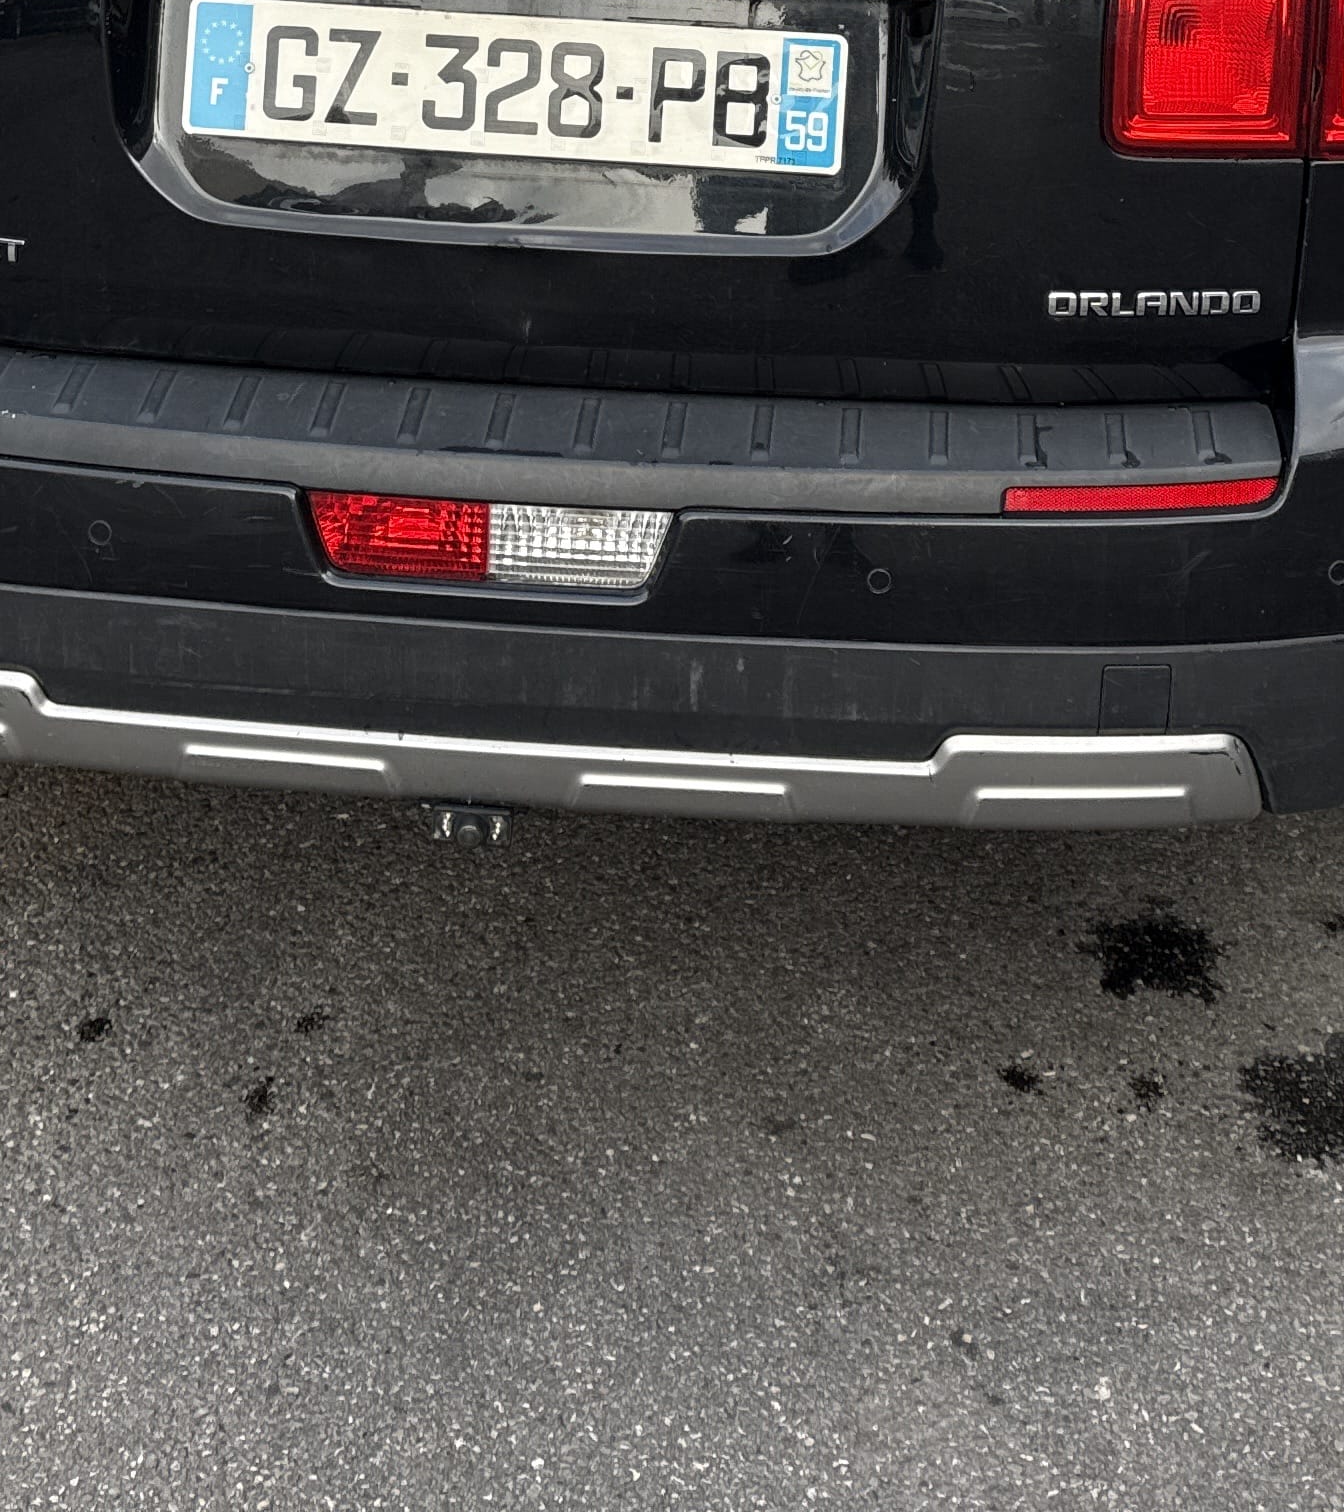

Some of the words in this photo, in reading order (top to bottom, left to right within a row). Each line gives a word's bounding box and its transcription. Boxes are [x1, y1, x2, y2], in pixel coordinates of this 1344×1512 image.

[210, 77, 229, 106] F
[263, 24, 771, 149] GZ-328-PB
[784, 110, 829, 152] 59
[1047, 290, 1262, 317] ORLANDO
